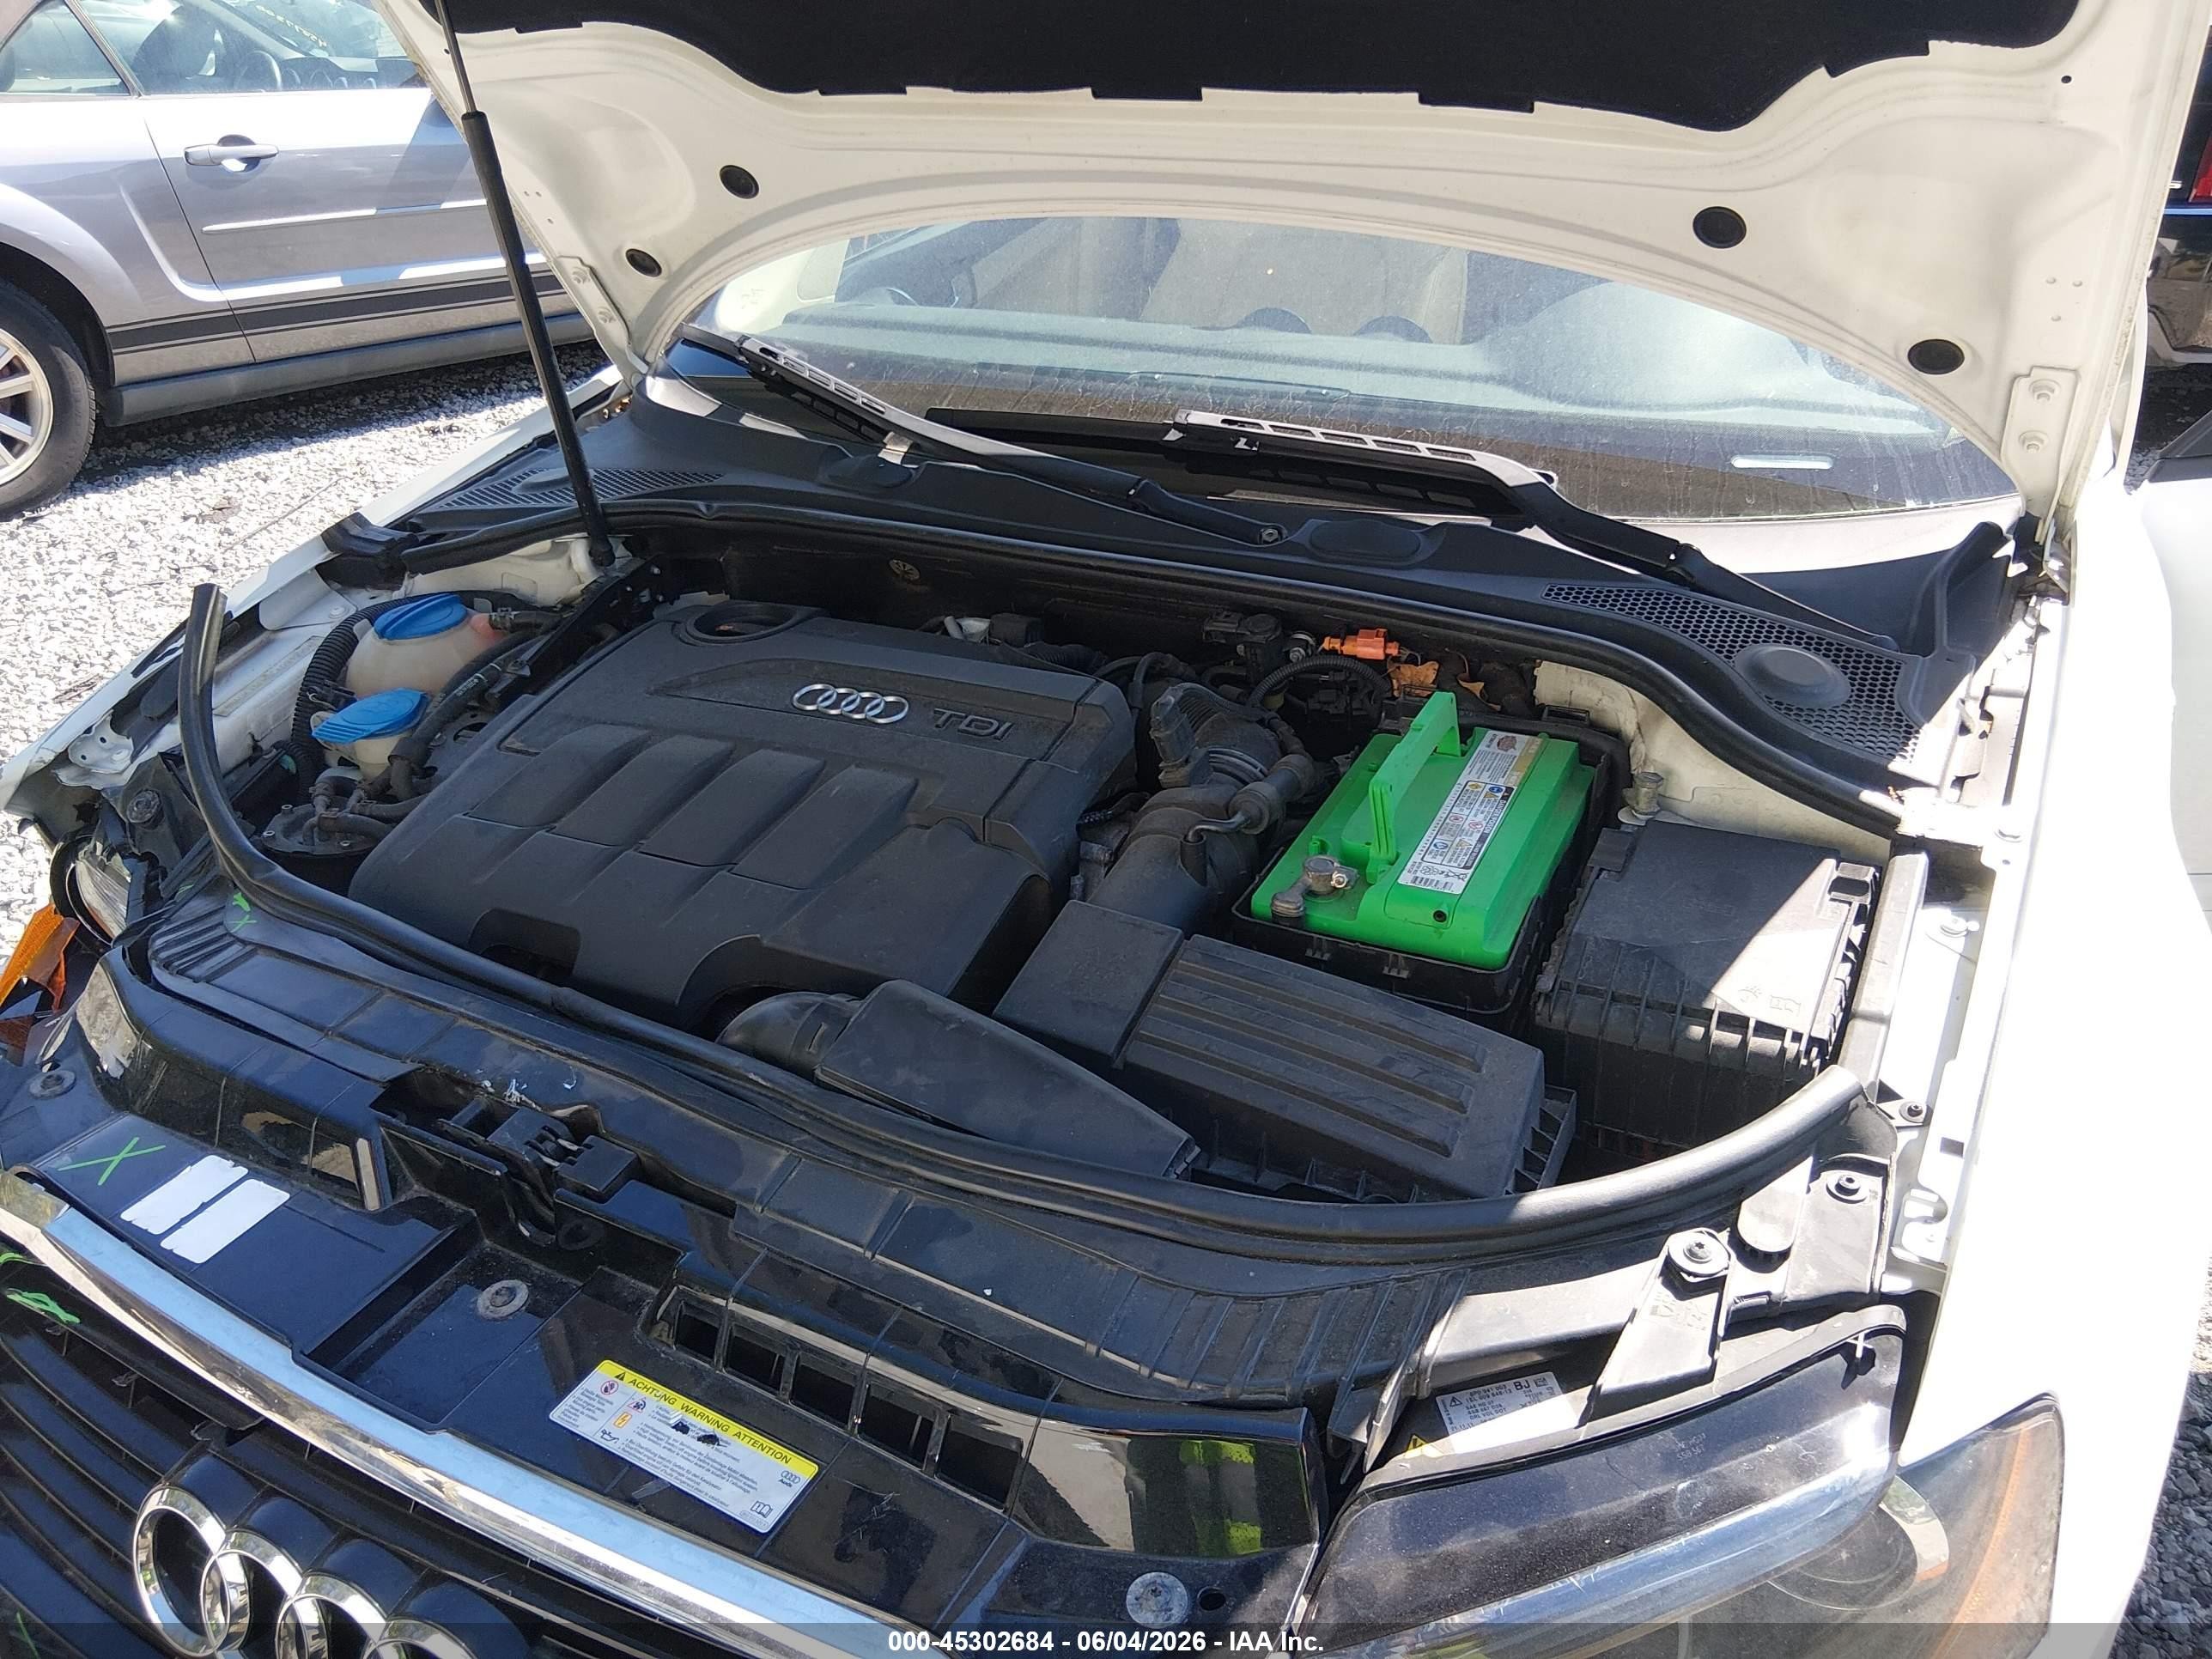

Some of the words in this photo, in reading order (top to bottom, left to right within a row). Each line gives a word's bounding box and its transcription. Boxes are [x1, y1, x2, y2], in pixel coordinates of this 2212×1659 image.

[933, 708, 1015, 742] TDI
[1513, 1380, 1530, 1391] BJ
[627, 1377, 678, 1406] ACHTUNG
[678, 1402, 732, 1433] WARNING
[732, 1429, 793, 1463] ATTENTION
